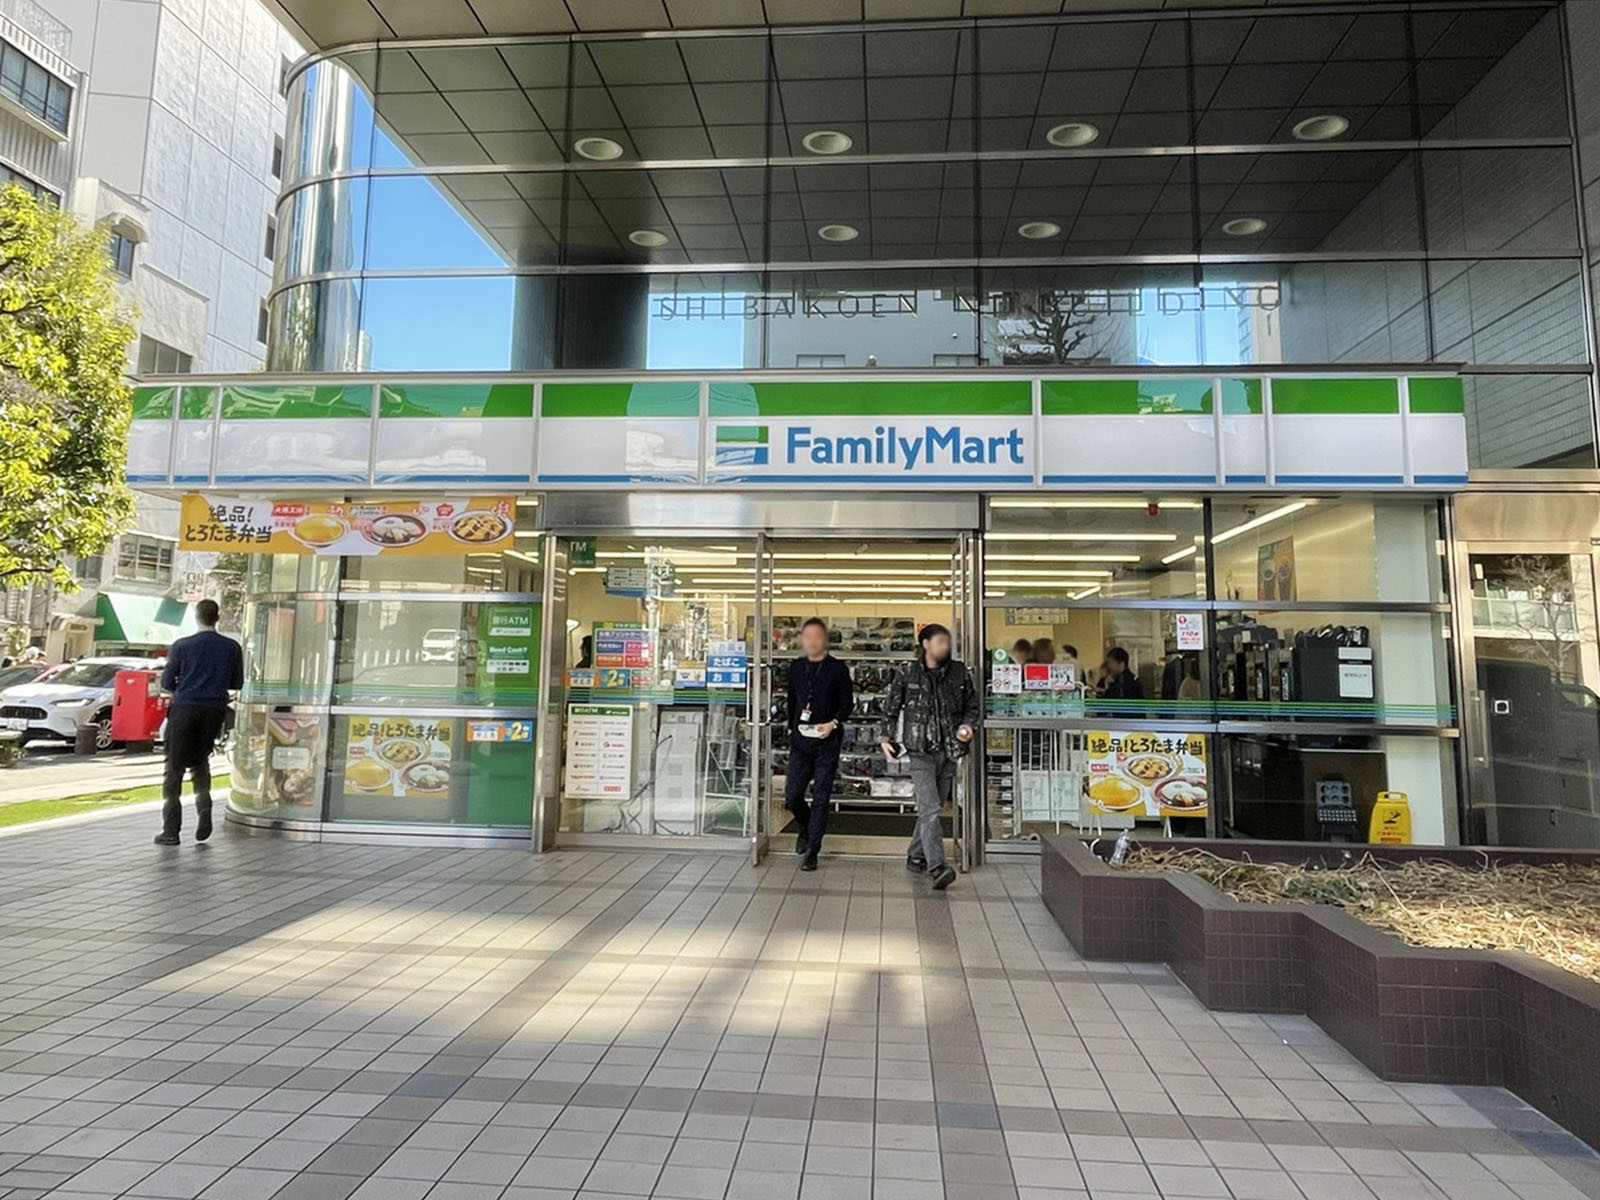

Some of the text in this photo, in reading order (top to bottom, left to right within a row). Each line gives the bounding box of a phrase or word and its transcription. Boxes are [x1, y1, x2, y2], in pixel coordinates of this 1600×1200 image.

[659, 293, 918, 321] SHIBAKOEN
[786, 426, 1024, 470] FamilyMart
[208, 505, 253, 522] 絶品!
[185, 525, 272, 543] とろたま弁当
[352, 722, 450, 741] 絶品!とろたま弁当
[1091, 738, 1203, 755] 絶品!とろたま弁当
